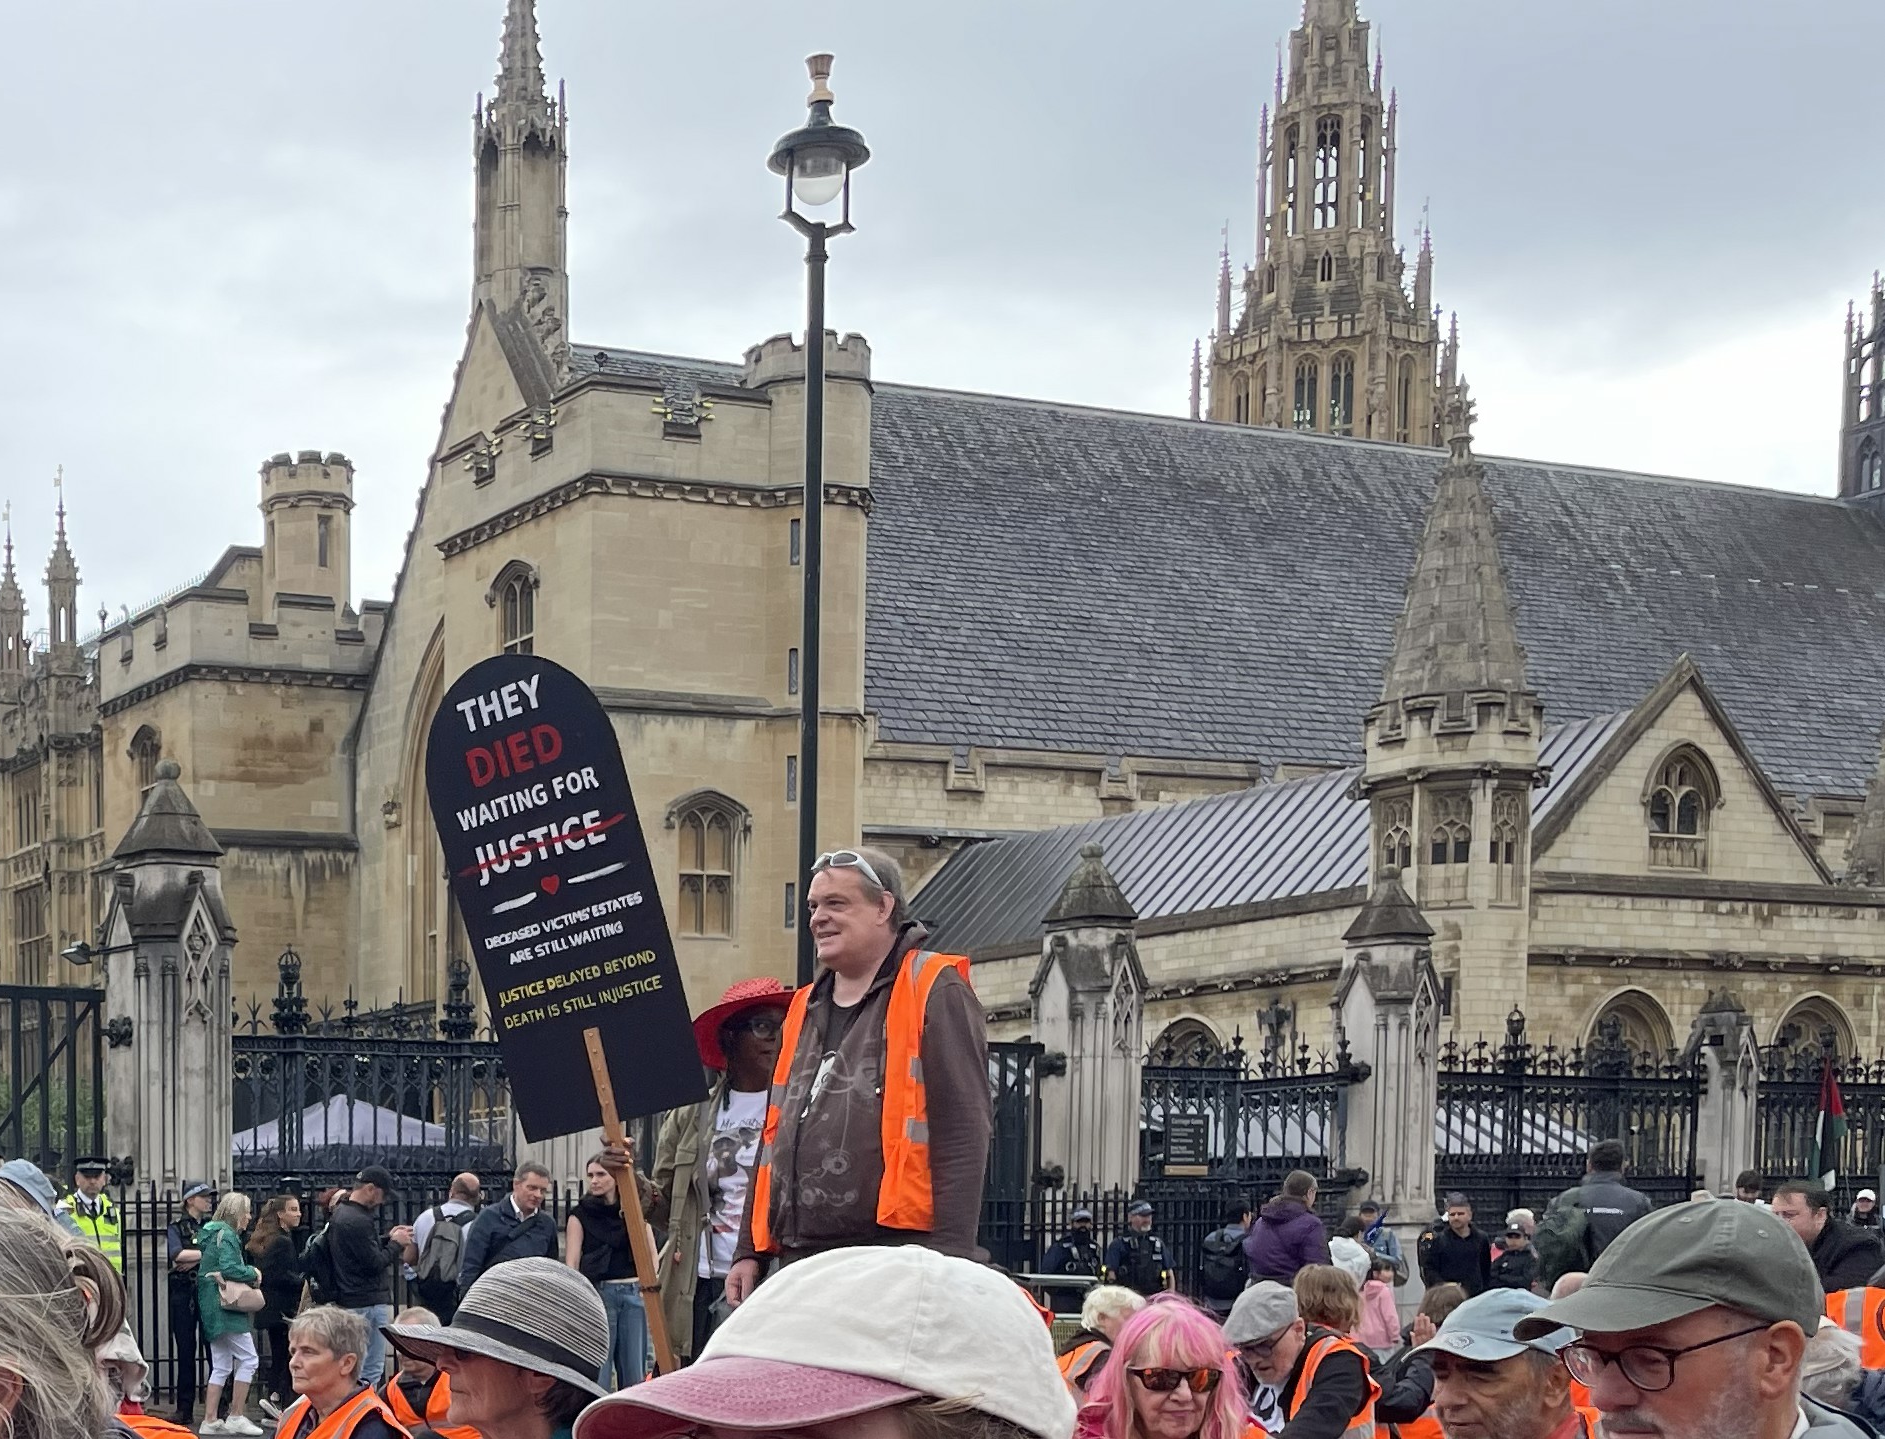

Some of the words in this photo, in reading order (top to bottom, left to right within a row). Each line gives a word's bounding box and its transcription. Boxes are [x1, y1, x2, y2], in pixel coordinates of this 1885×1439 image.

[456, 673, 540, 733] THEY
[465, 724, 563, 788] DIED
[455, 783, 549, 832] WAITING
[552, 766, 600, 800] FOR
[474, 809, 607, 887] JUSTICE
[484, 923, 541, 950] DECEASED
[592, 891, 643, 917] ESTATES
[509, 948, 534, 965] ARE
[534, 937, 569, 958] STILL
[568, 920, 624, 947] WAITING
[499, 980, 546, 1008] JUSTICE
[546, 965, 601, 991] DELAYED
[603, 949, 657, 975] BEYOND
[503, 1007, 545, 1030] DEATH
[548, 1003, 561, 1018] IS
[562, 994, 597, 1014] STILL
[598, 974, 663, 1004] INJUSTICE
